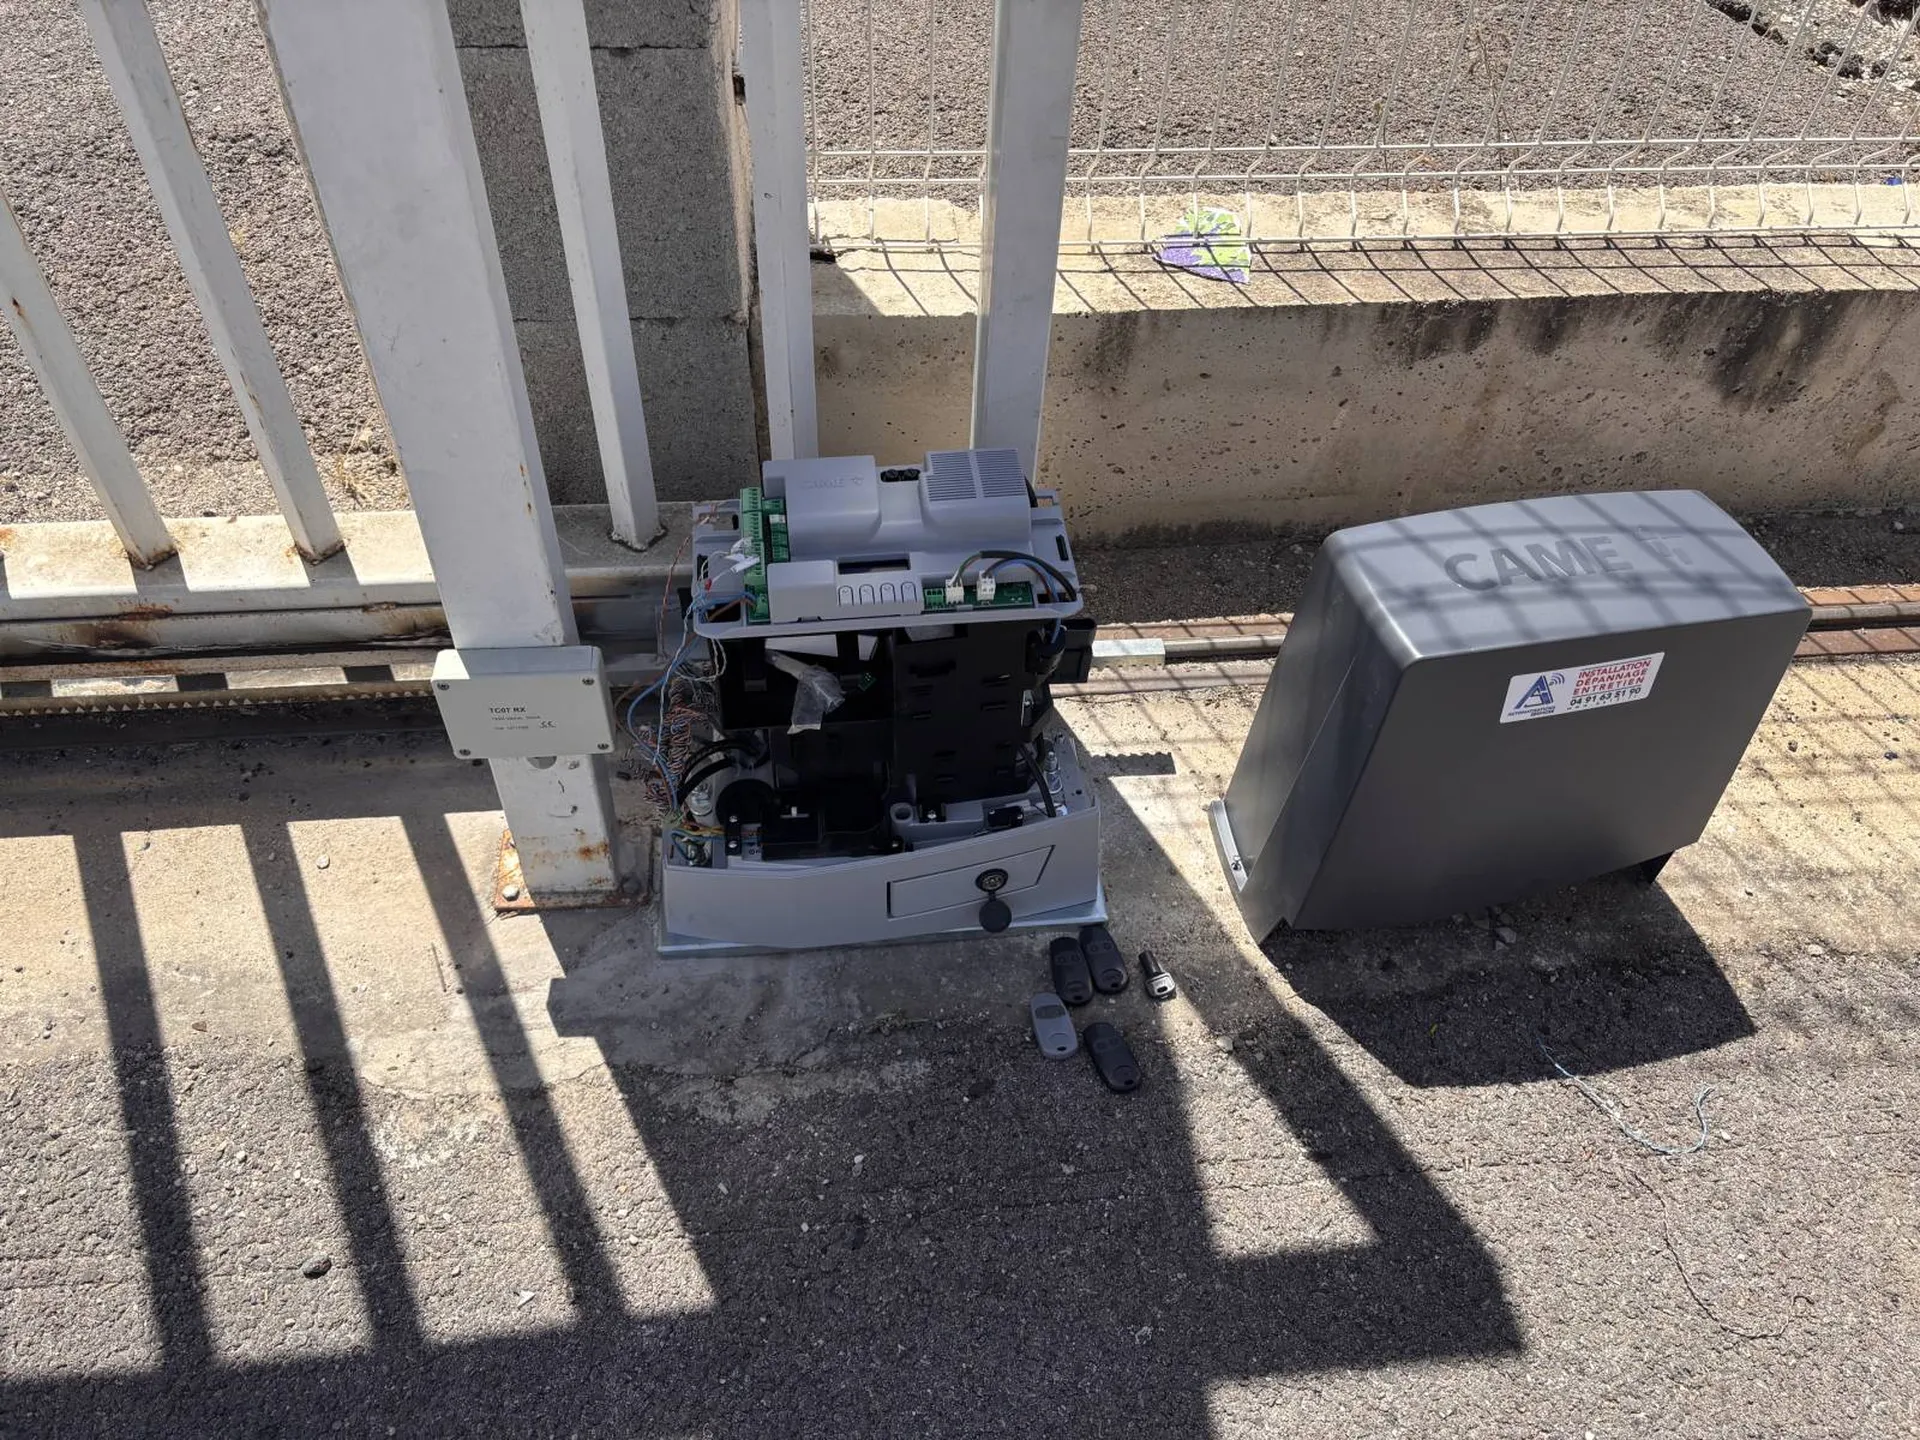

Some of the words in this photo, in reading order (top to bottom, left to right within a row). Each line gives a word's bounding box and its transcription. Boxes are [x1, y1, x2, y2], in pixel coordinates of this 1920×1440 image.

[1444, 535, 1634, 591] CAME
[1578, 660, 1652, 679] INSTALLATION
[1572, 677, 1645, 696] ENTRETIEN
[1570, 698, 1582, 706] 04
[1585, 695, 1597, 703] 91
